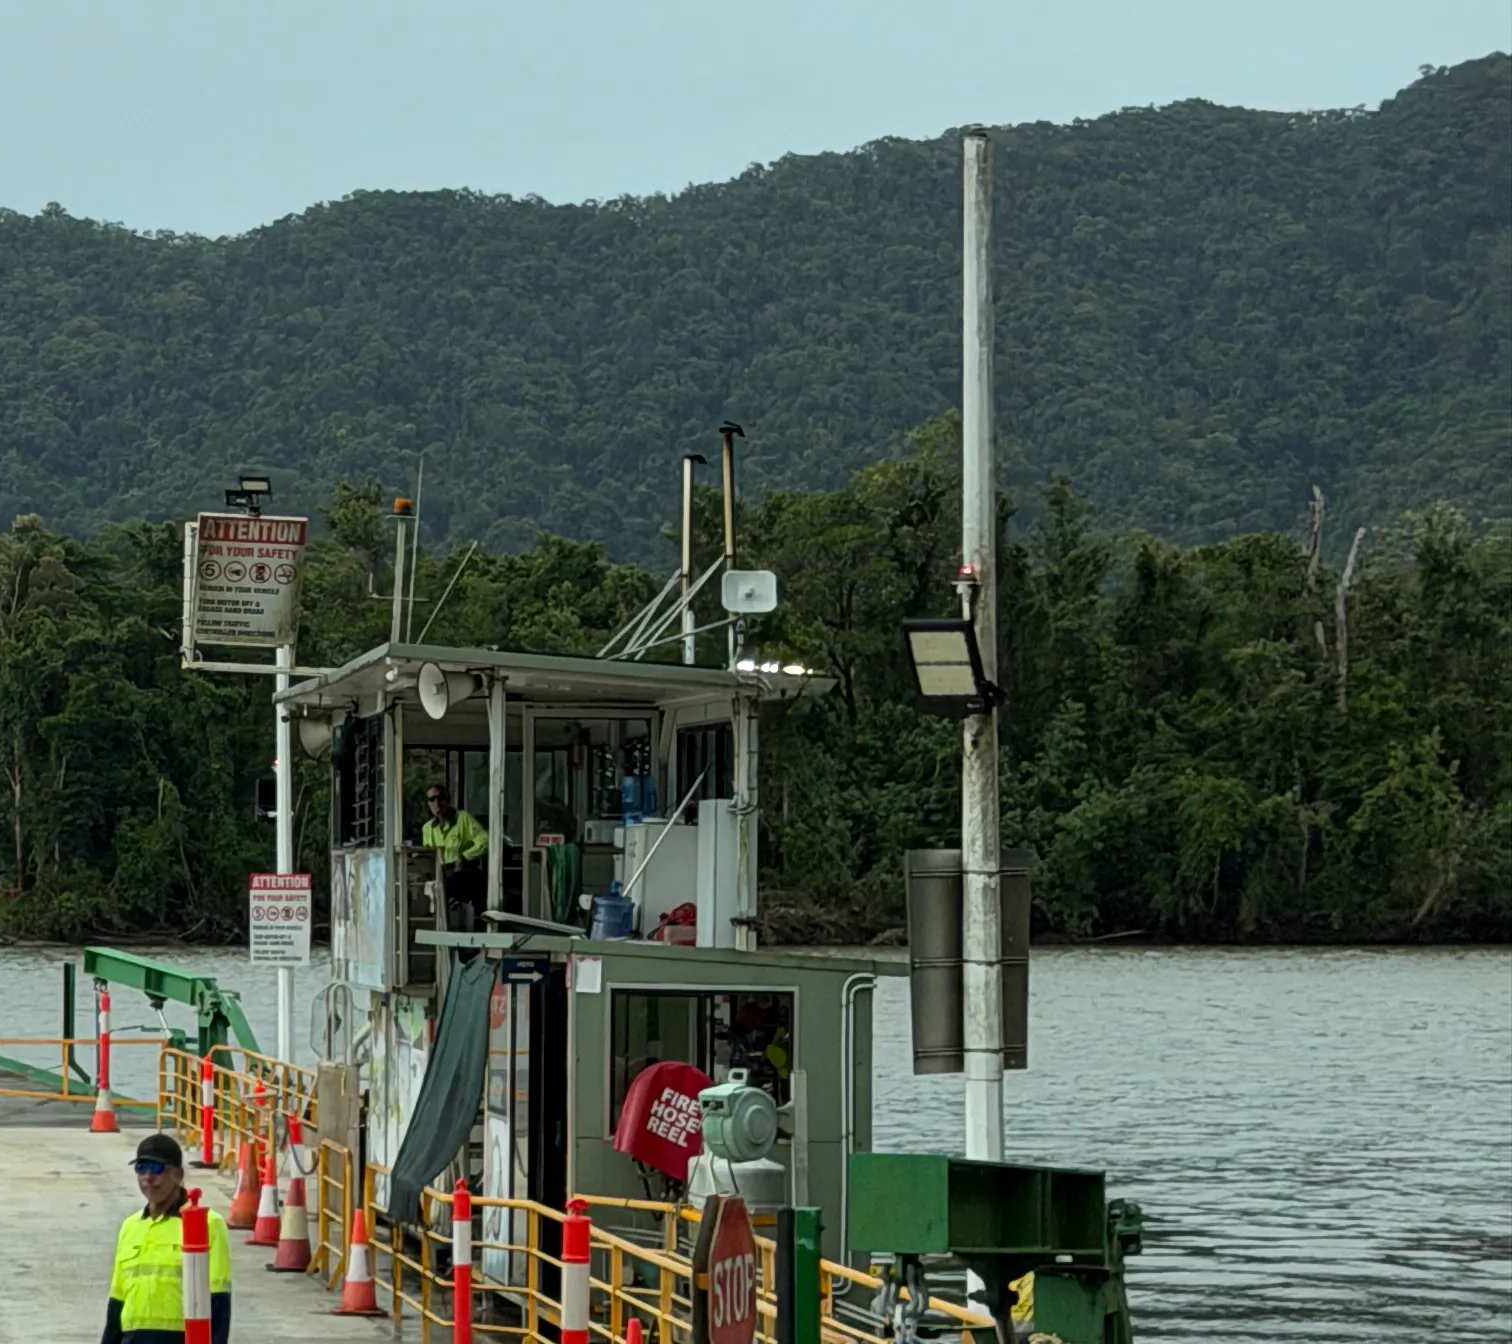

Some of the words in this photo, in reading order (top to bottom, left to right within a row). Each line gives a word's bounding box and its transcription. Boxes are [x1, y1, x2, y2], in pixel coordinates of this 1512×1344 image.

[203, 519, 301, 542] ATTENTION
[201, 545, 223, 556] FOR
[227, 546, 254, 557] YOUR
[257, 547, 298, 559] SAFETY
[252, 876, 309, 888] ATTENTION
[660, 1087, 700, 1116] FIRE
[646, 1115, 688, 1148] REEL
[650, 1100, 700, 1134] HOSE
[714, 1253, 754, 1328] STOP
